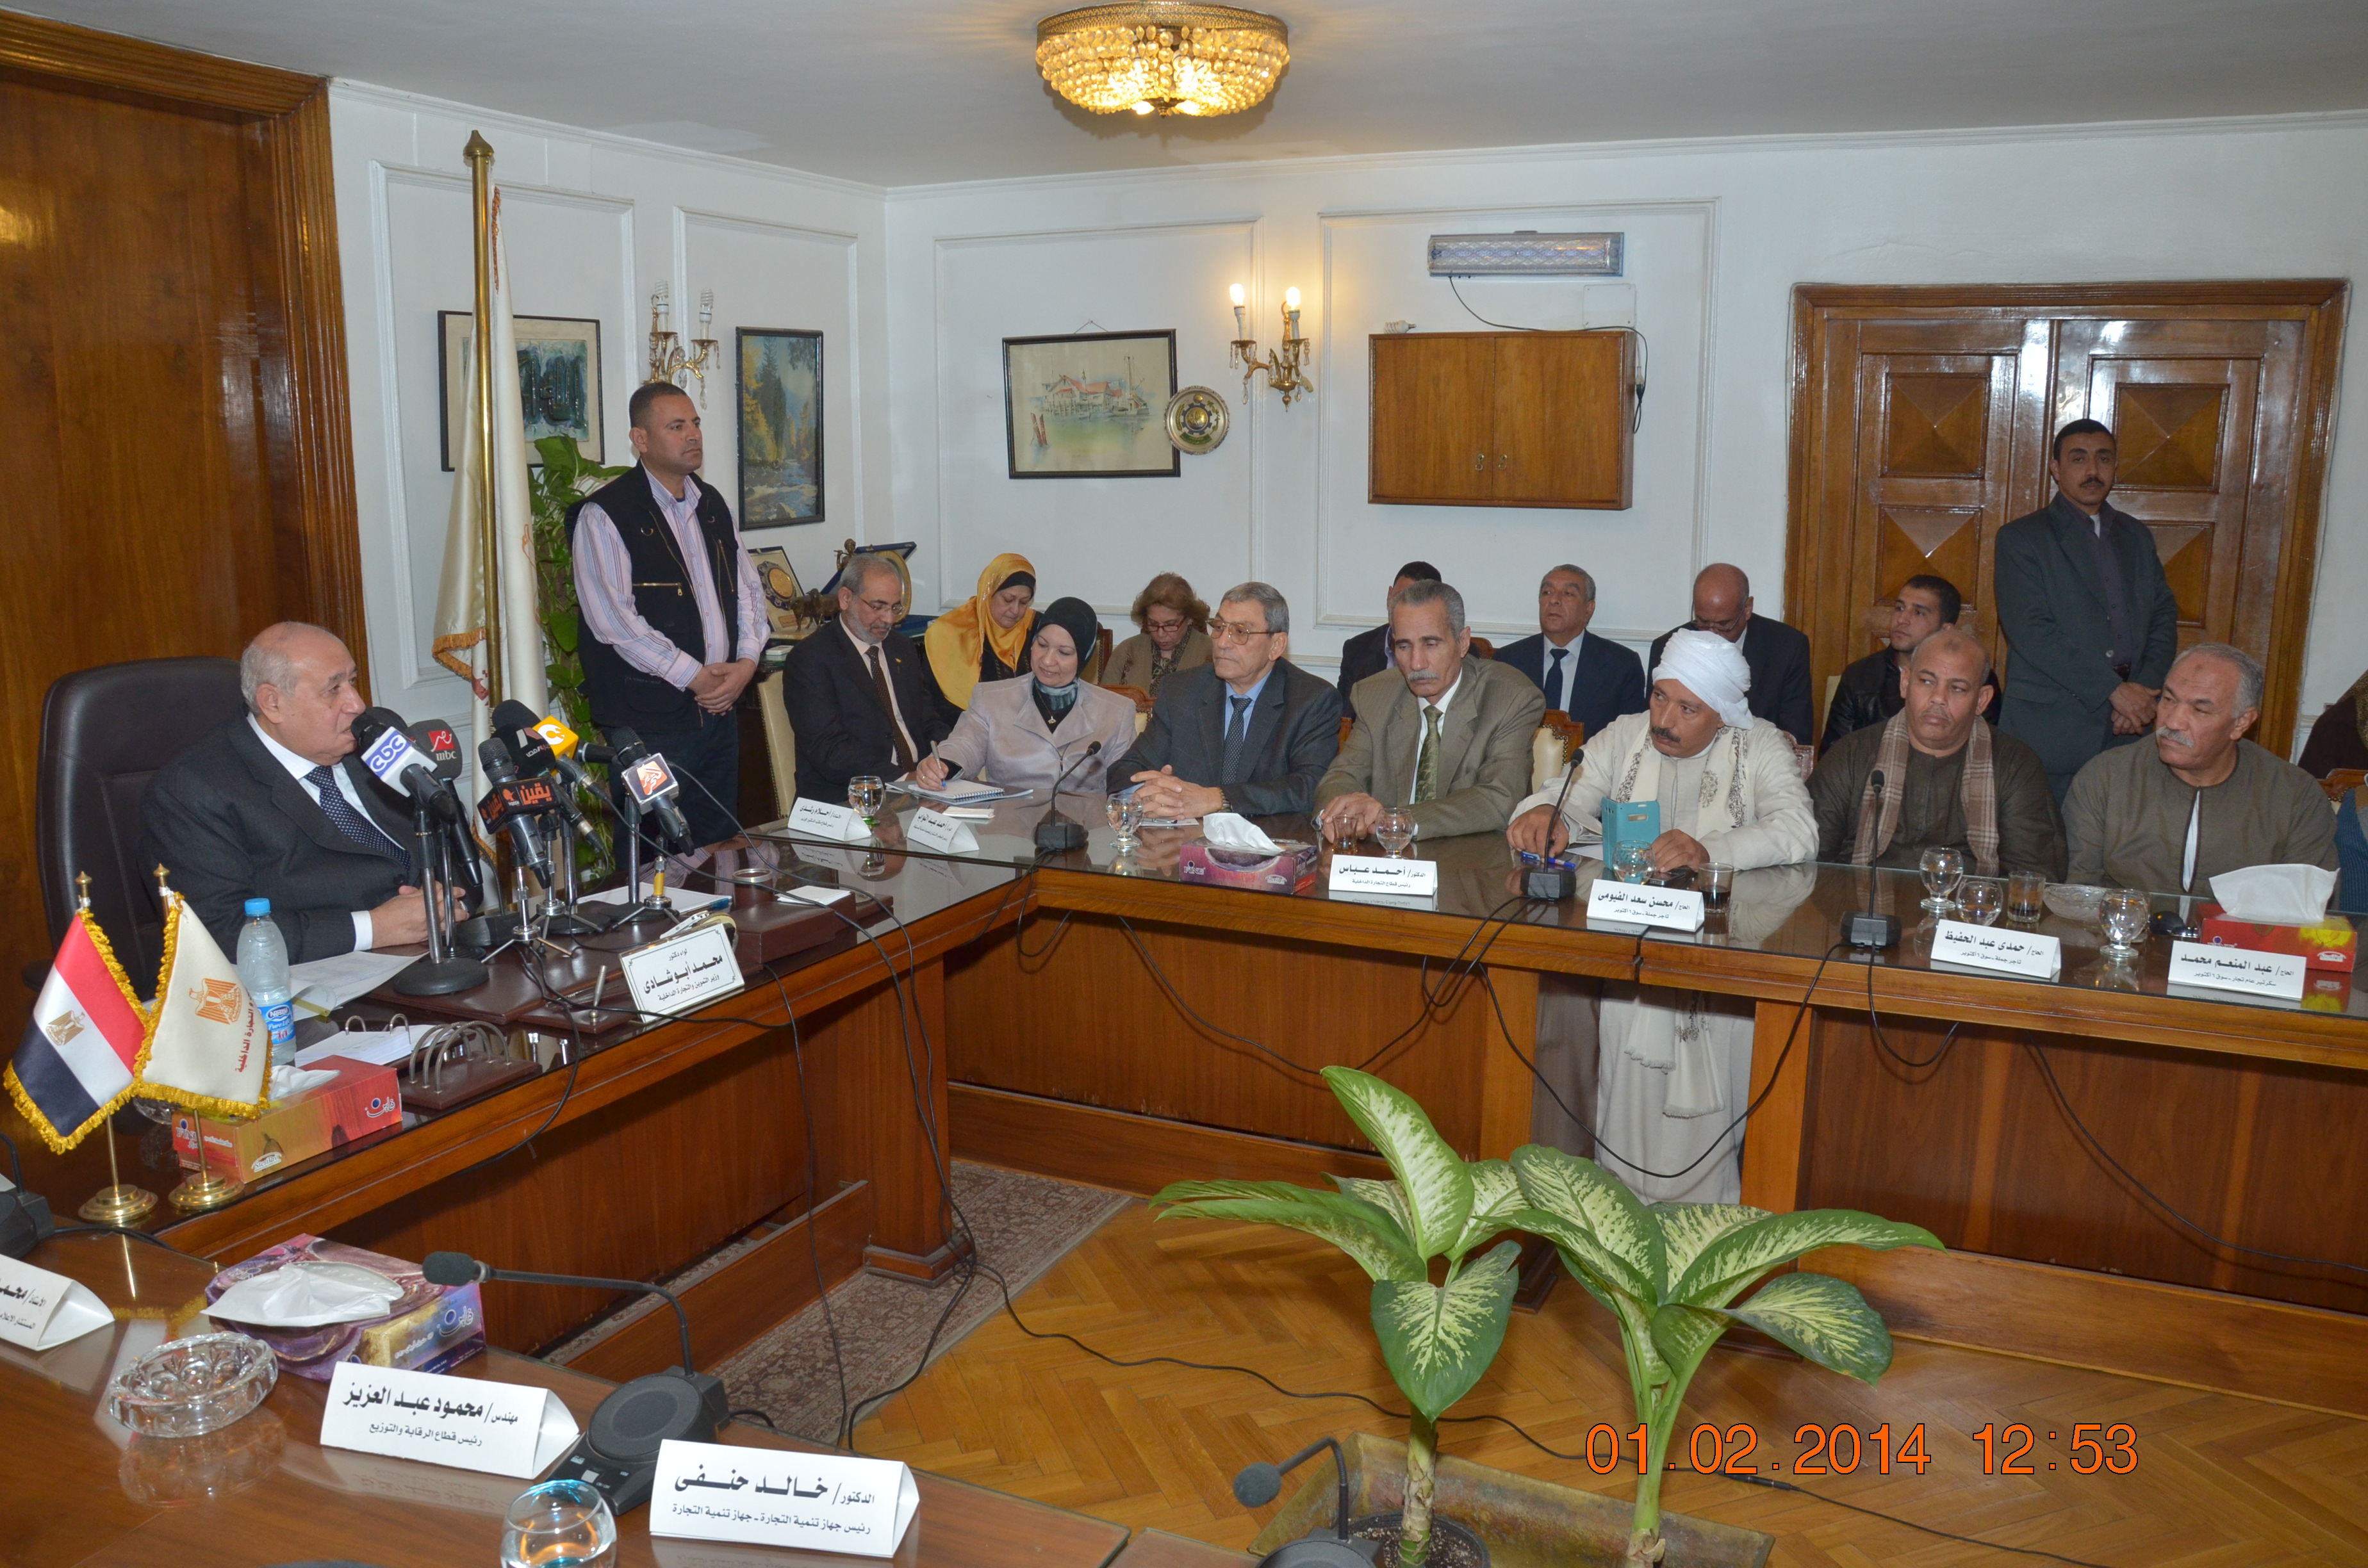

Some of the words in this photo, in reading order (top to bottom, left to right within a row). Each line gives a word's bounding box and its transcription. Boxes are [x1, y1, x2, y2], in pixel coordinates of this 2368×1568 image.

[370, 734, 407, 772] cbc
[436, 750, 457, 761] mbc
[520, 782, 552, 805] يقين
[1339, 865, 1370, 874] عباس
[1372, 867, 1406, 876] أحمد
[1598, 892, 1628, 902] الفيومى
[1631, 893, 1647, 904] سعد
[1649, 897, 1673, 907] محسن
[1945, 931, 1977, 943] الحفيظ
[1979, 938, 1995, 949] عبد
[1998, 942, 2025, 952] حمدى
[669, 952, 680, 961] دكتور
[2181, 953, 2212, 964] محمد
[693, 954, 723, 973] محمد
[2215, 959, 2251, 970] المنعم
[2254, 961, 2272, 974] عبد
[675, 961, 691, 983] أبو
[644, 969, 673, 993] شادى
[695, 977, 709, 988] التموين
[711, 975, 719, 983] وزير
[678, 982, 695, 993] والتجارة
[659, 989, 677, 1001] الداخلية
[234, 1039, 251, 1072] الداخلية
[0, 1285, 29, 1299] محم
[342, 1382, 391, 1408] العزيز
[393, 1391, 431, 1416] عبد
[433, 1396, 483, 1419] محمود
[369, 1422, 402, 1436] والتوزيع
[404, 1425, 433, 1440] الرقابة
[434, 1430, 456, 1442] قطاع
[457, 1435, 482, 1446] رئيس
[675, 1464, 749, 1491] حنفى
[755, 1476, 828, 1499] خالد
[672, 1503, 703, 1515] التجارة
[705, 1505, 730, 1520] تنمية
[733, 1509, 752, 1521] جهاز
[760, 1512, 791, 1525] التجارة
[794, 1514, 819, 1529] تنمية
[820, 1518, 842, 1531] جهاز
[844, 1522, 871, 1535] رئيس
